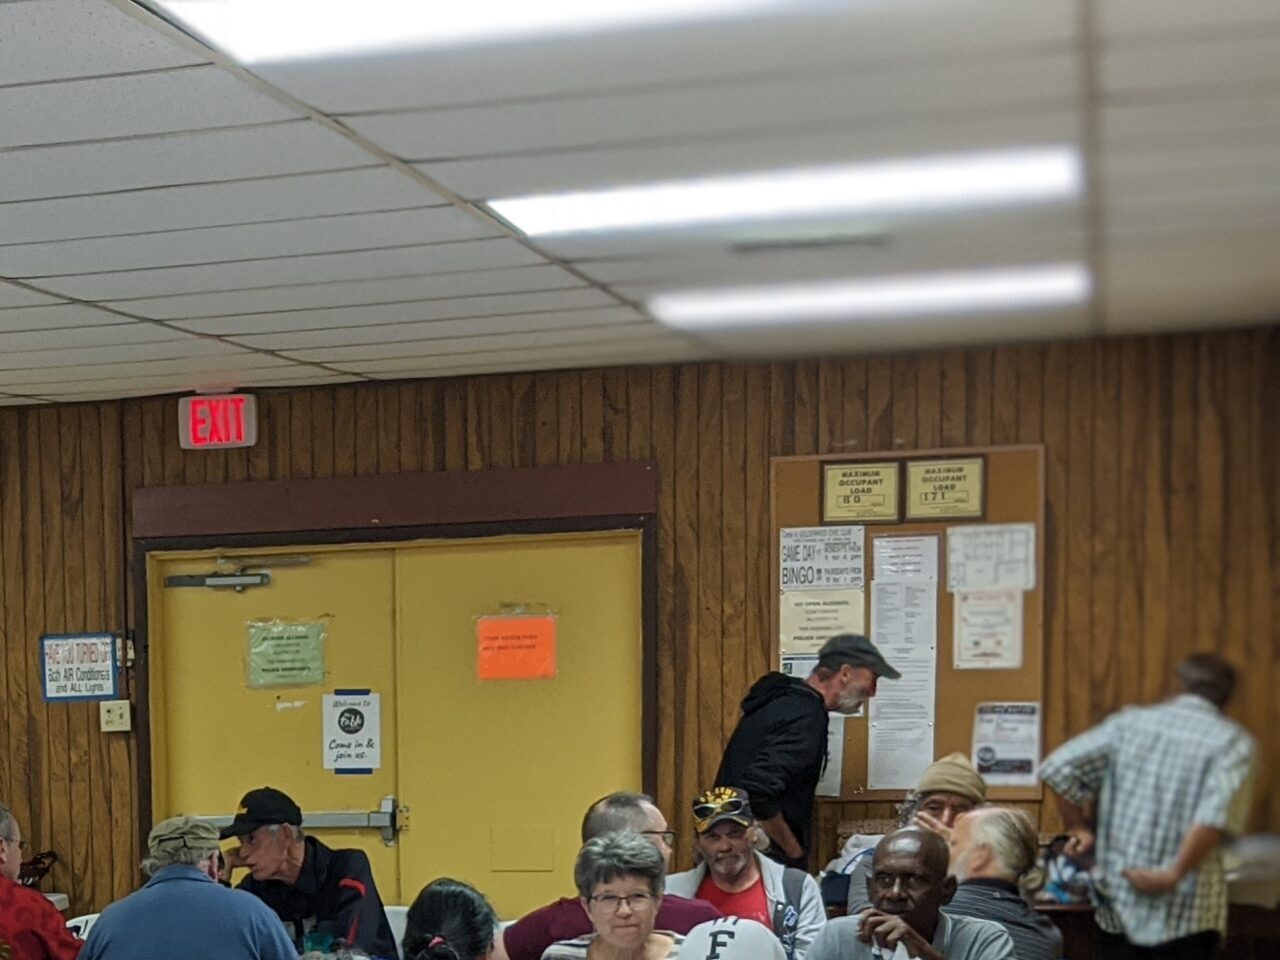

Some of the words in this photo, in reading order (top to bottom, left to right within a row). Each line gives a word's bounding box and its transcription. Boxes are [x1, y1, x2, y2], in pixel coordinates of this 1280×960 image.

[191, 397, 244, 444] EXIT
[841, 470, 881, 478] MAXIMUM
[924, 466, 964, 475] MAXIMUM
[838, 478, 883, 487] OCCUPANT
[922, 475, 967, 483] OCCUPANT
[850, 487, 872, 495] LOAD
[933, 483, 956, 491] LOAD
[782, 544, 800, 563] GAME
[802, 544, 817, 562] DAY
[782, 566, 815, 585] BINGO
[48, 667, 61, 682] Both
[63, 667, 74, 681] AIR
[76, 666, 111, 681] Conditioners
[56, 684, 68, 693] and
[70, 683, 82, 692] ALL
[85, 682, 104, 695] Lights
[328, 738, 352, 750] Come
[354, 740, 364, 749] in
[365, 738, 375, 749] &
[333, 750, 352, 763] join
